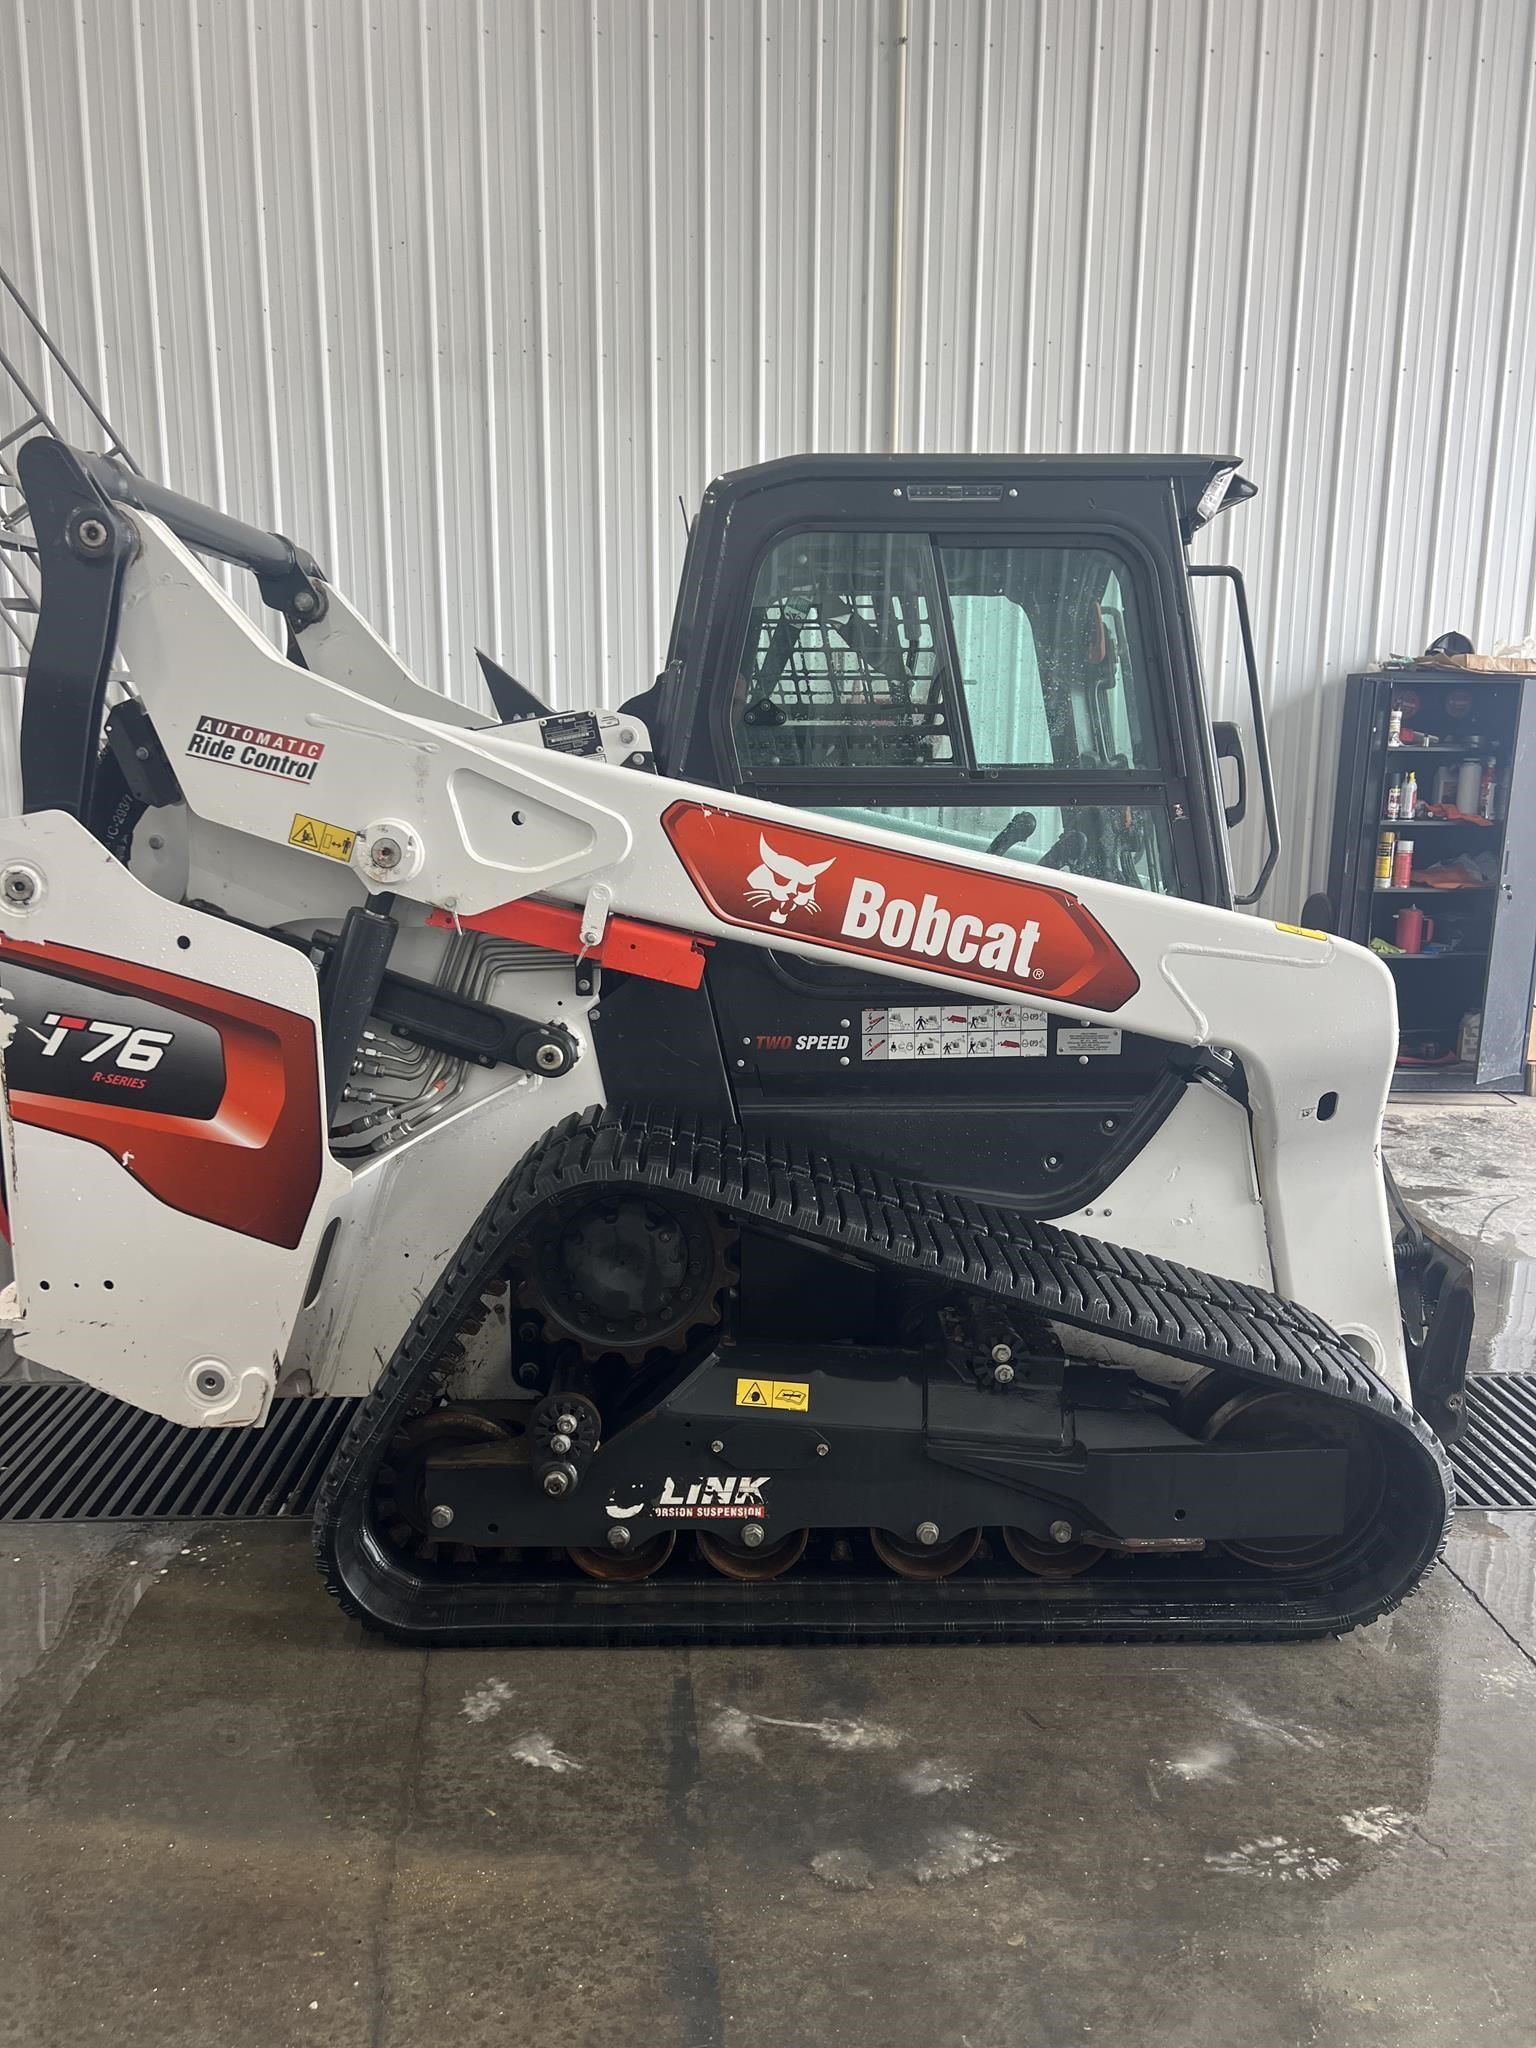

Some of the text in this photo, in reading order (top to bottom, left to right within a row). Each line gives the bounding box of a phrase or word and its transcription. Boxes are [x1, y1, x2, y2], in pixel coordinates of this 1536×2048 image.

[187, 733, 318, 780] Ride Control
[201, 719, 319, 757] AUTOMATIC
[840, 877, 1040, 978] Bobcat
[41, 1013, 174, 1072] T76
[756, 1035, 850, 1050] TWO SPEED
[92, 1071, 147, 1090] R-SERIES
[696, 1507, 762, 1519] SUSPENSION
